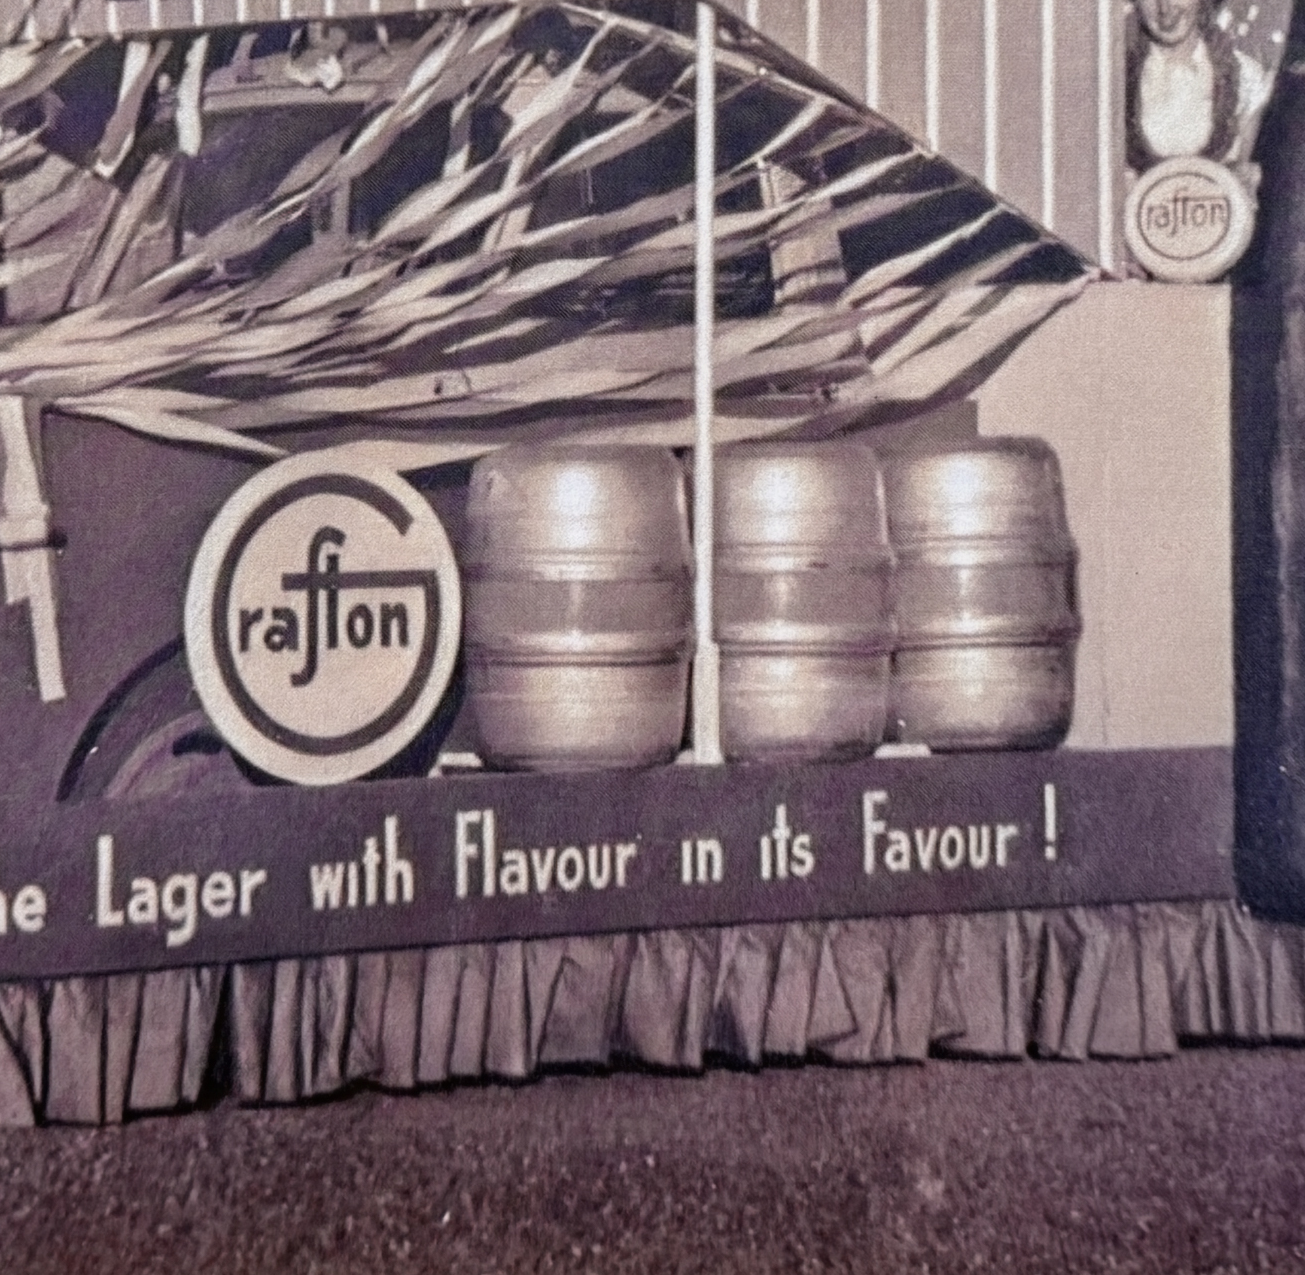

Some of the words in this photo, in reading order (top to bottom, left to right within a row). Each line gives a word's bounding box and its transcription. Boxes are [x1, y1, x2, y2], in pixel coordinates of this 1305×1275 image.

[211, 473, 442, 757] Grafton
[96, 834, 267, 949] Lager
[309, 814, 414, 912] with
[455, 809, 638, 900] Flavour
[681, 837, 724, 885] in
[760, 803, 815, 880] its
